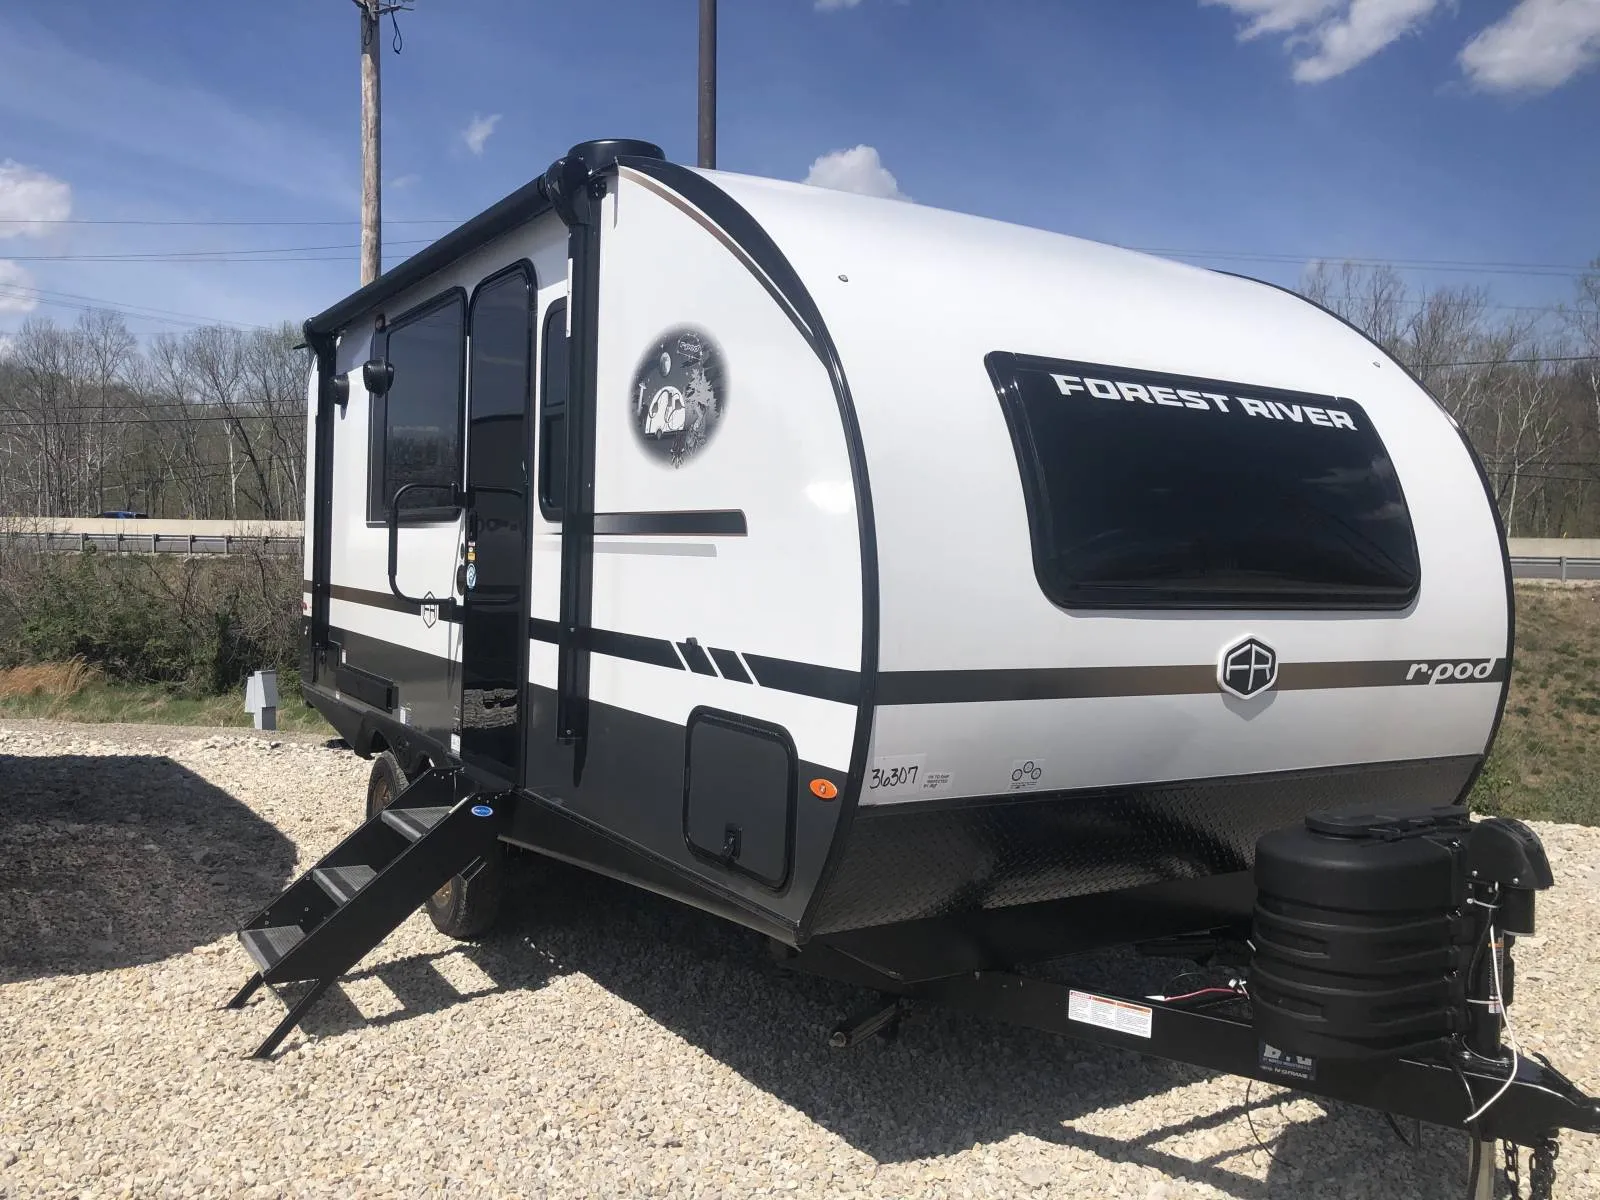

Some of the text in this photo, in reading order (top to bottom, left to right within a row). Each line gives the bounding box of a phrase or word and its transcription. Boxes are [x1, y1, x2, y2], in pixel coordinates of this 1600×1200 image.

[1049, 373, 1358, 431] FOREST RIVER
[869, 766, 918, 789] 36307
